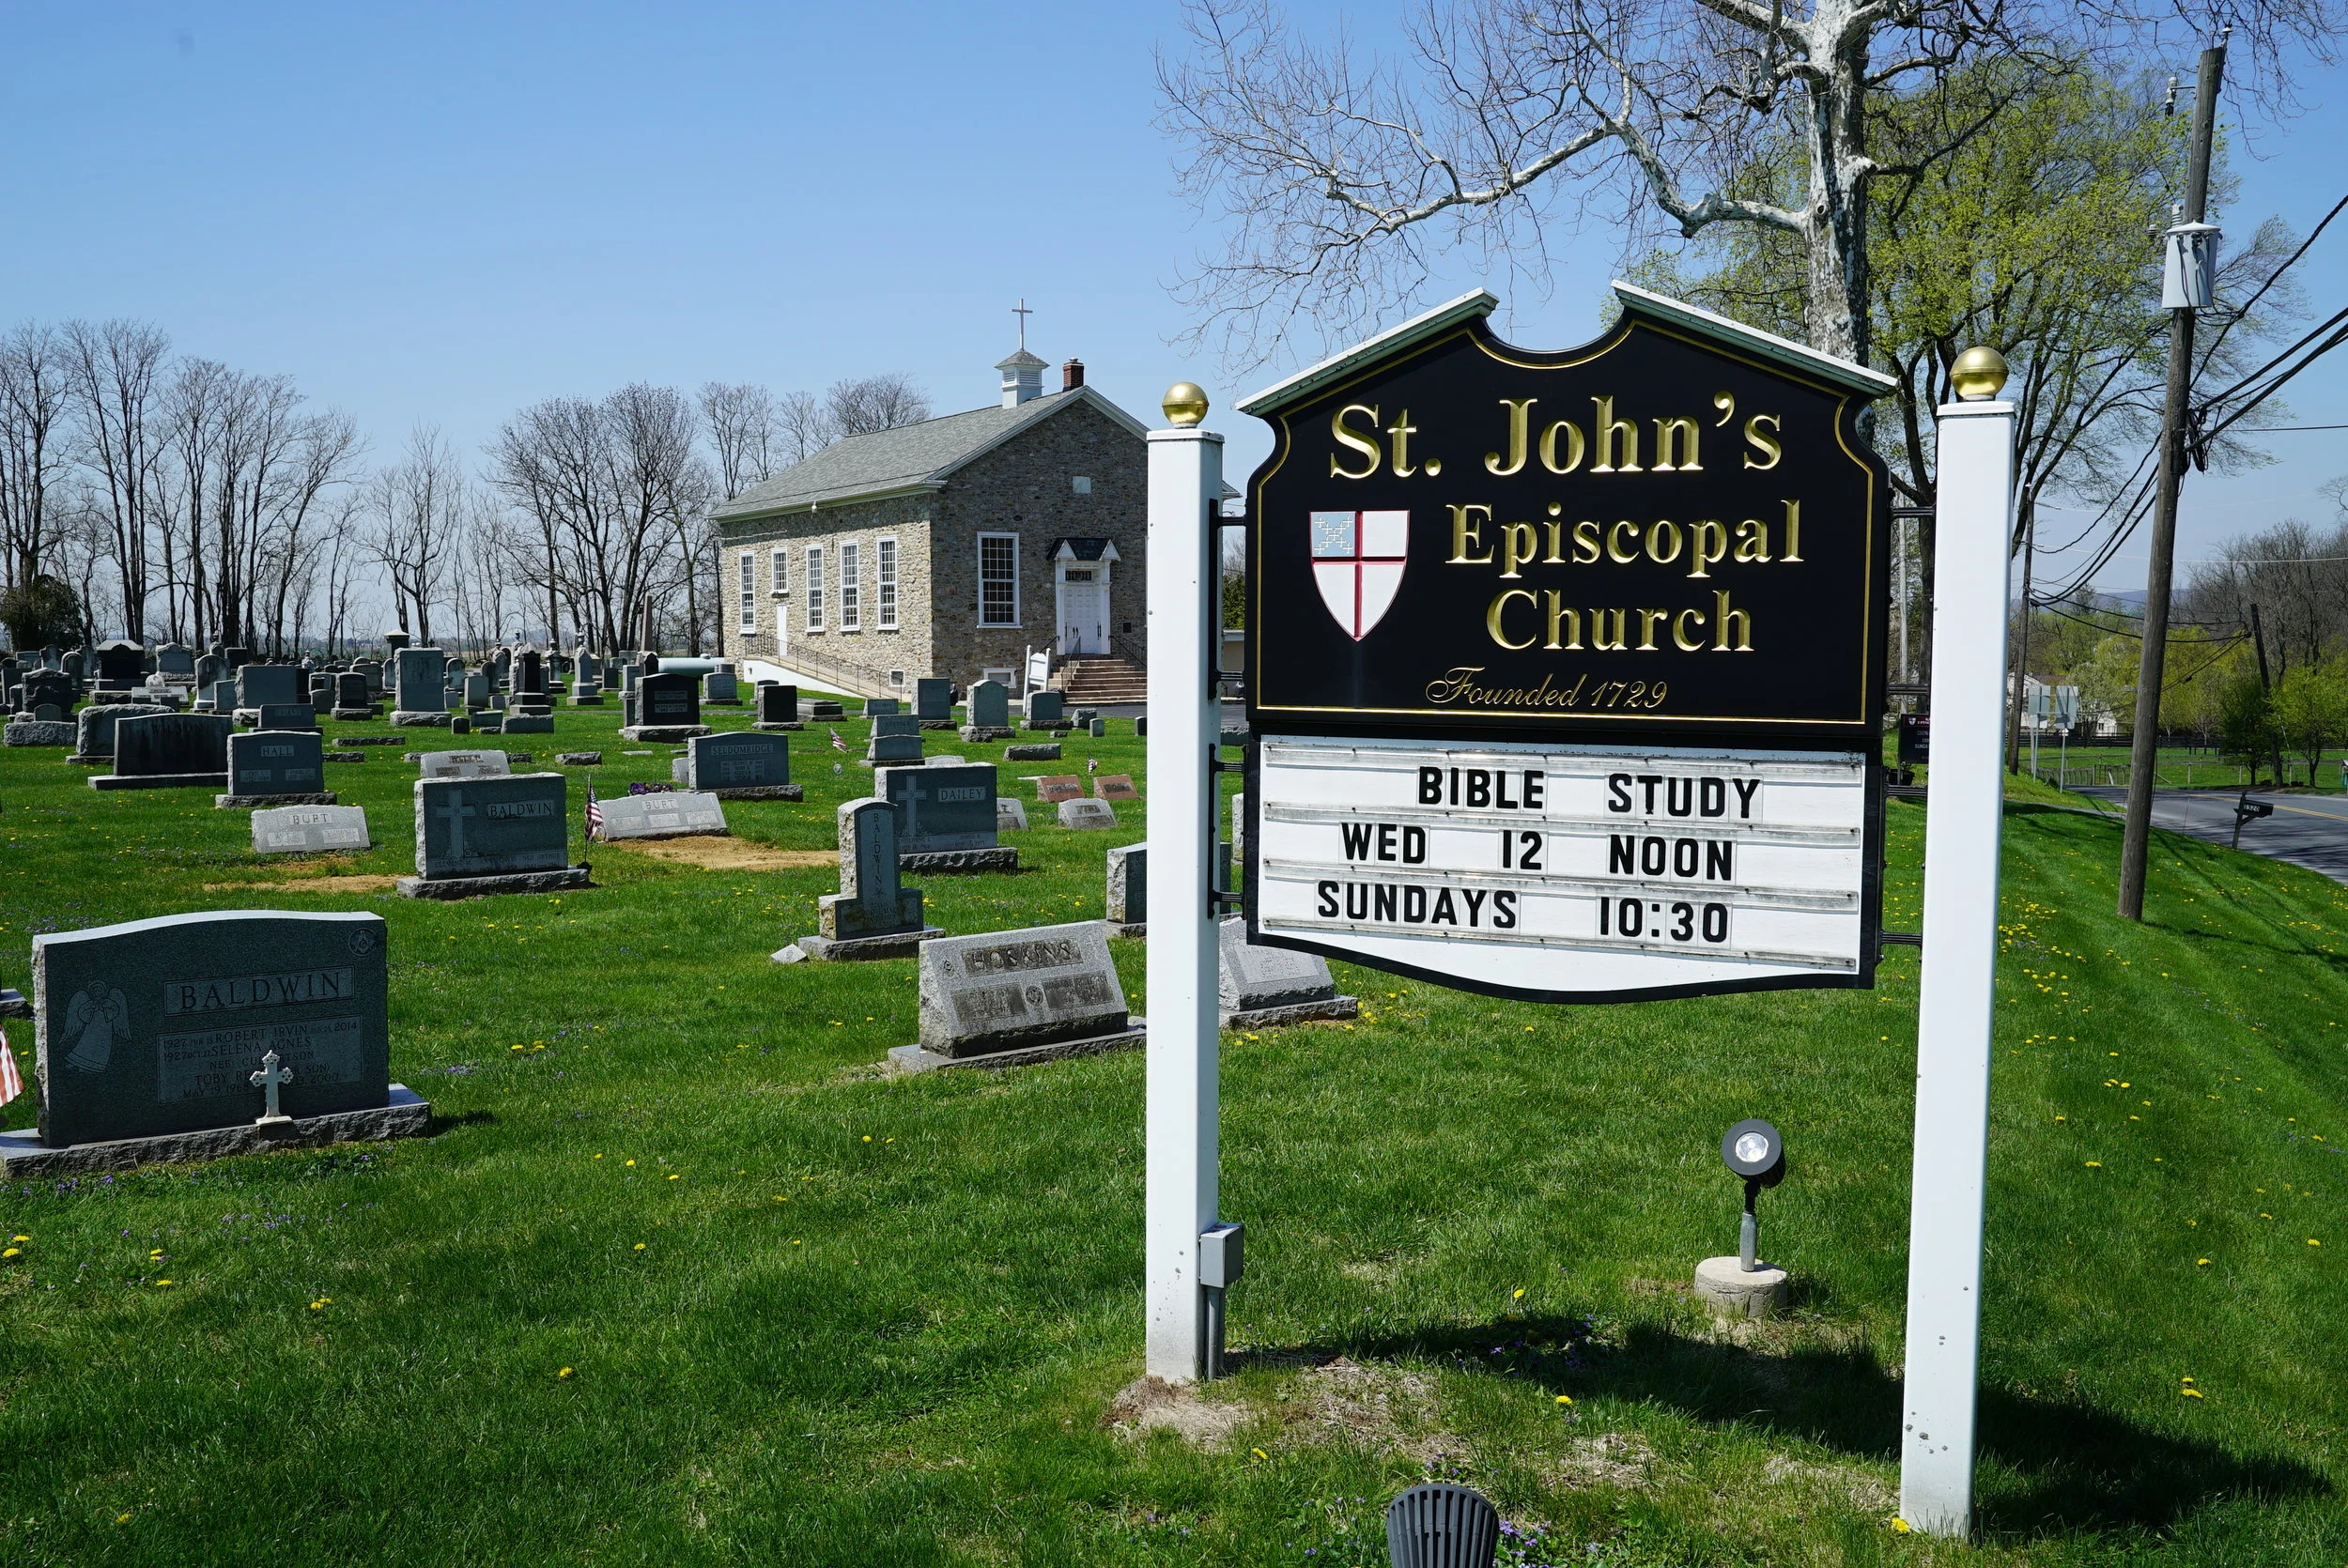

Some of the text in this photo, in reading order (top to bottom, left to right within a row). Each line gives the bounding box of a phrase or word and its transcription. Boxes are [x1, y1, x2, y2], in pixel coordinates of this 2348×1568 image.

[1330, 391, 1782, 479] St. John's
[1445, 500, 1804, 578] Episcopal
[1486, 589, 1755, 652] Church
[1425, 667, 1668, 710] Founded 1729
[262, 746, 293, 756] HALL
[712, 744, 772, 756] SELDOMRIDGE
[644, 799, 674, 810] BURT
[940, 788, 983, 801] DAILEY
[1418, 766, 1760, 820] BIBLE STUDY
[292, 813, 328, 825] BURT
[489, 802, 552, 817] BALDWIN
[873, 812, 883, 884] BALDWIN
[1341, 822, 1733, 881] WED 12 NOON
[1317, 880, 1728, 944] SUNDAYS 10:30
[971, 942, 1072, 970] HOSKINS
[179, 972, 340, 1011] BALDWIN
[163, 1038, 187, 1050] 1927
[215, 1028, 265, 1043] ROBERT
[273, 1024, 308, 1037] IRVIN
[333, 1022, 358, 1032] 2014
[211, 1042, 262, 1056] SELENA
[269, 1037, 311, 1051] AGNES
[209, 1059, 232, 1070] NEE
[183, 1088, 205, 1098] MAY
[193, 1072, 227, 1087] TOBY
